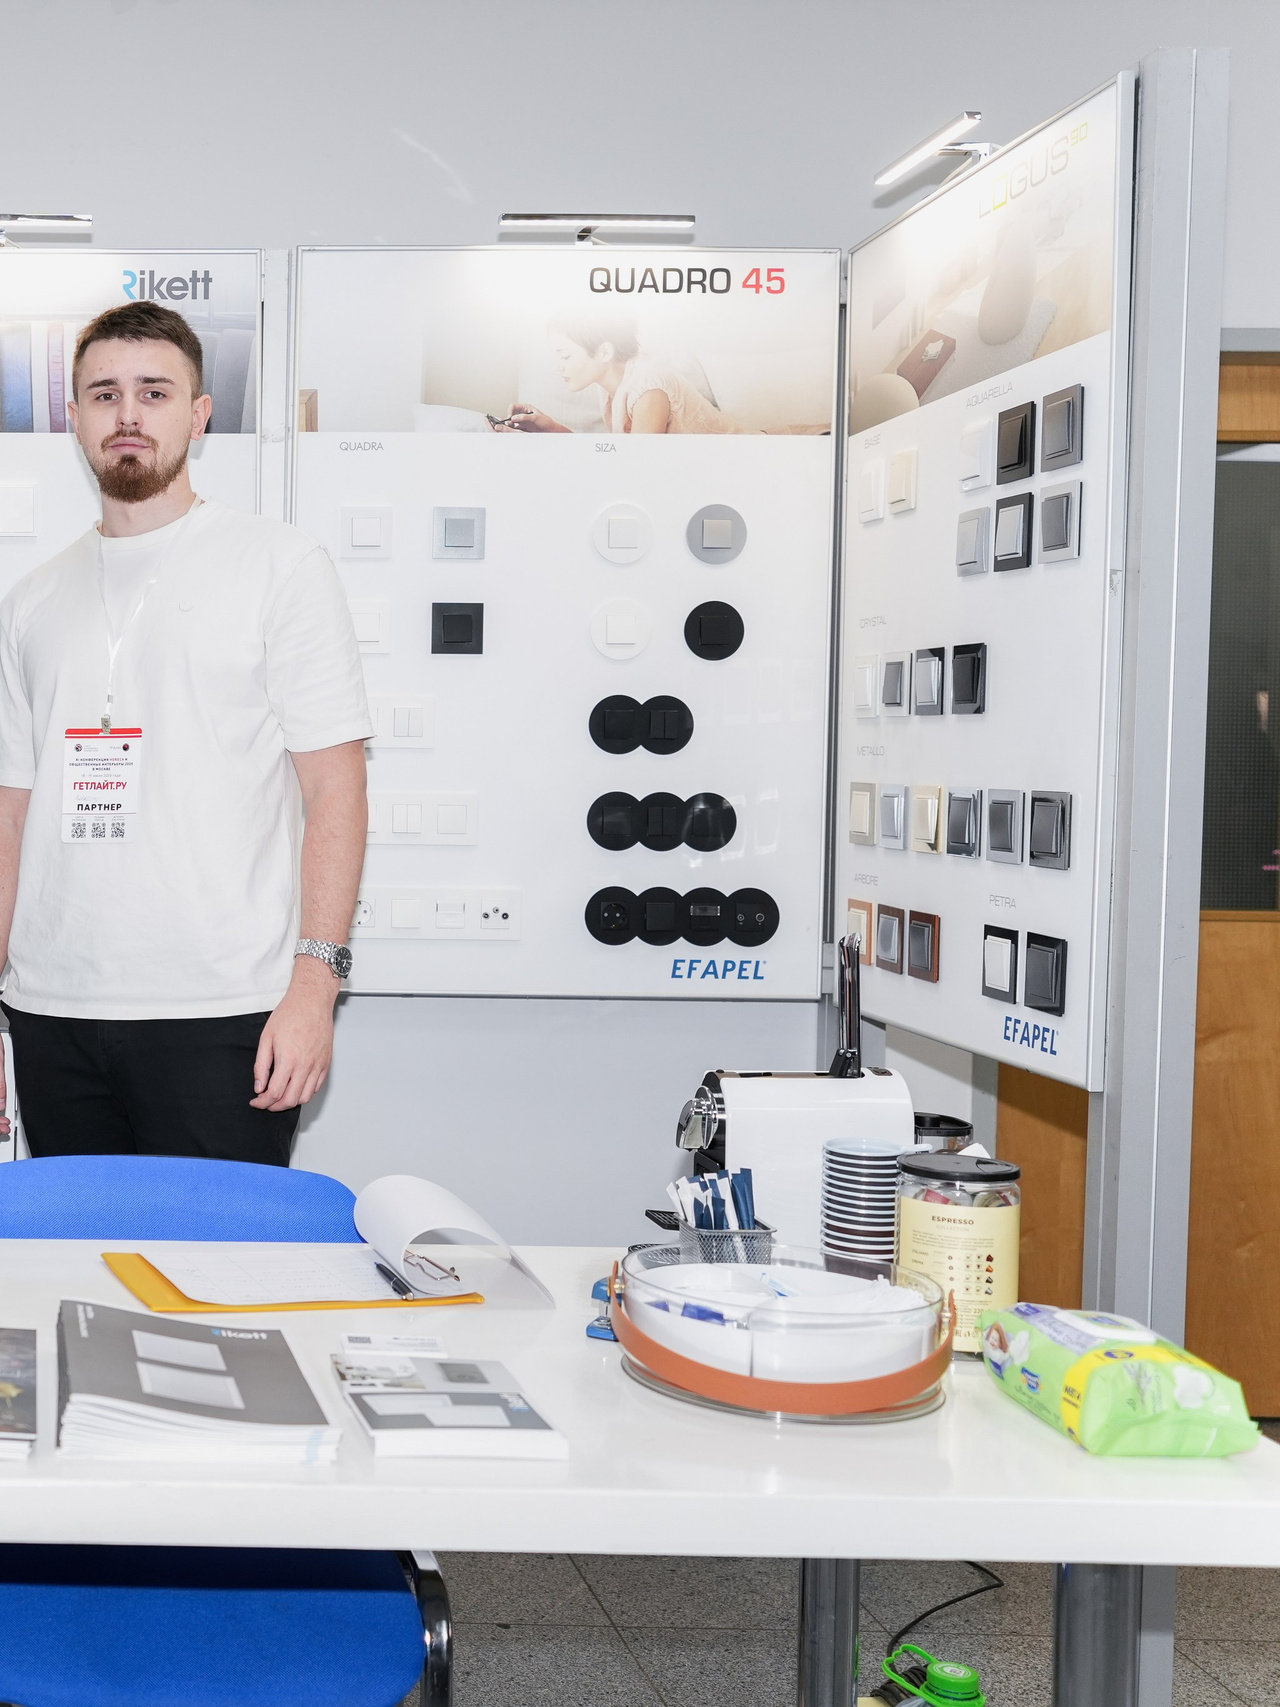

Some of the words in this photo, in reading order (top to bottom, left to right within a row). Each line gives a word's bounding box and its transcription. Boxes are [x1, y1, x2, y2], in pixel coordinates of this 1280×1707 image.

[122, 270, 213, 301] Rikett
[589, 267, 732, 294] QUADRO
[742, 267, 785, 294] 45
[965, 381, 1014, 410] AQUARELLA
[339, 441, 384, 452] QUADRA
[595, 442, 617, 453] SIZA
[864, 433, 881, 450] BASE
[859, 616, 887, 629] CRYSTAL
[856, 746, 885, 756] METALLO
[73, 780, 127, 790] ГЕТЛАЙТ.РУ
[77, 803, 122, 811] ПАРТНЕР
[854, 873, 879, 886] ARBORE
[989, 894, 1017, 909] PETRA
[671, 959, 765, 980] EFAPEL
[1003, 1015, 1058, 1056] EFAPEL
[931, 1215, 975, 1226] ESPRESSO
